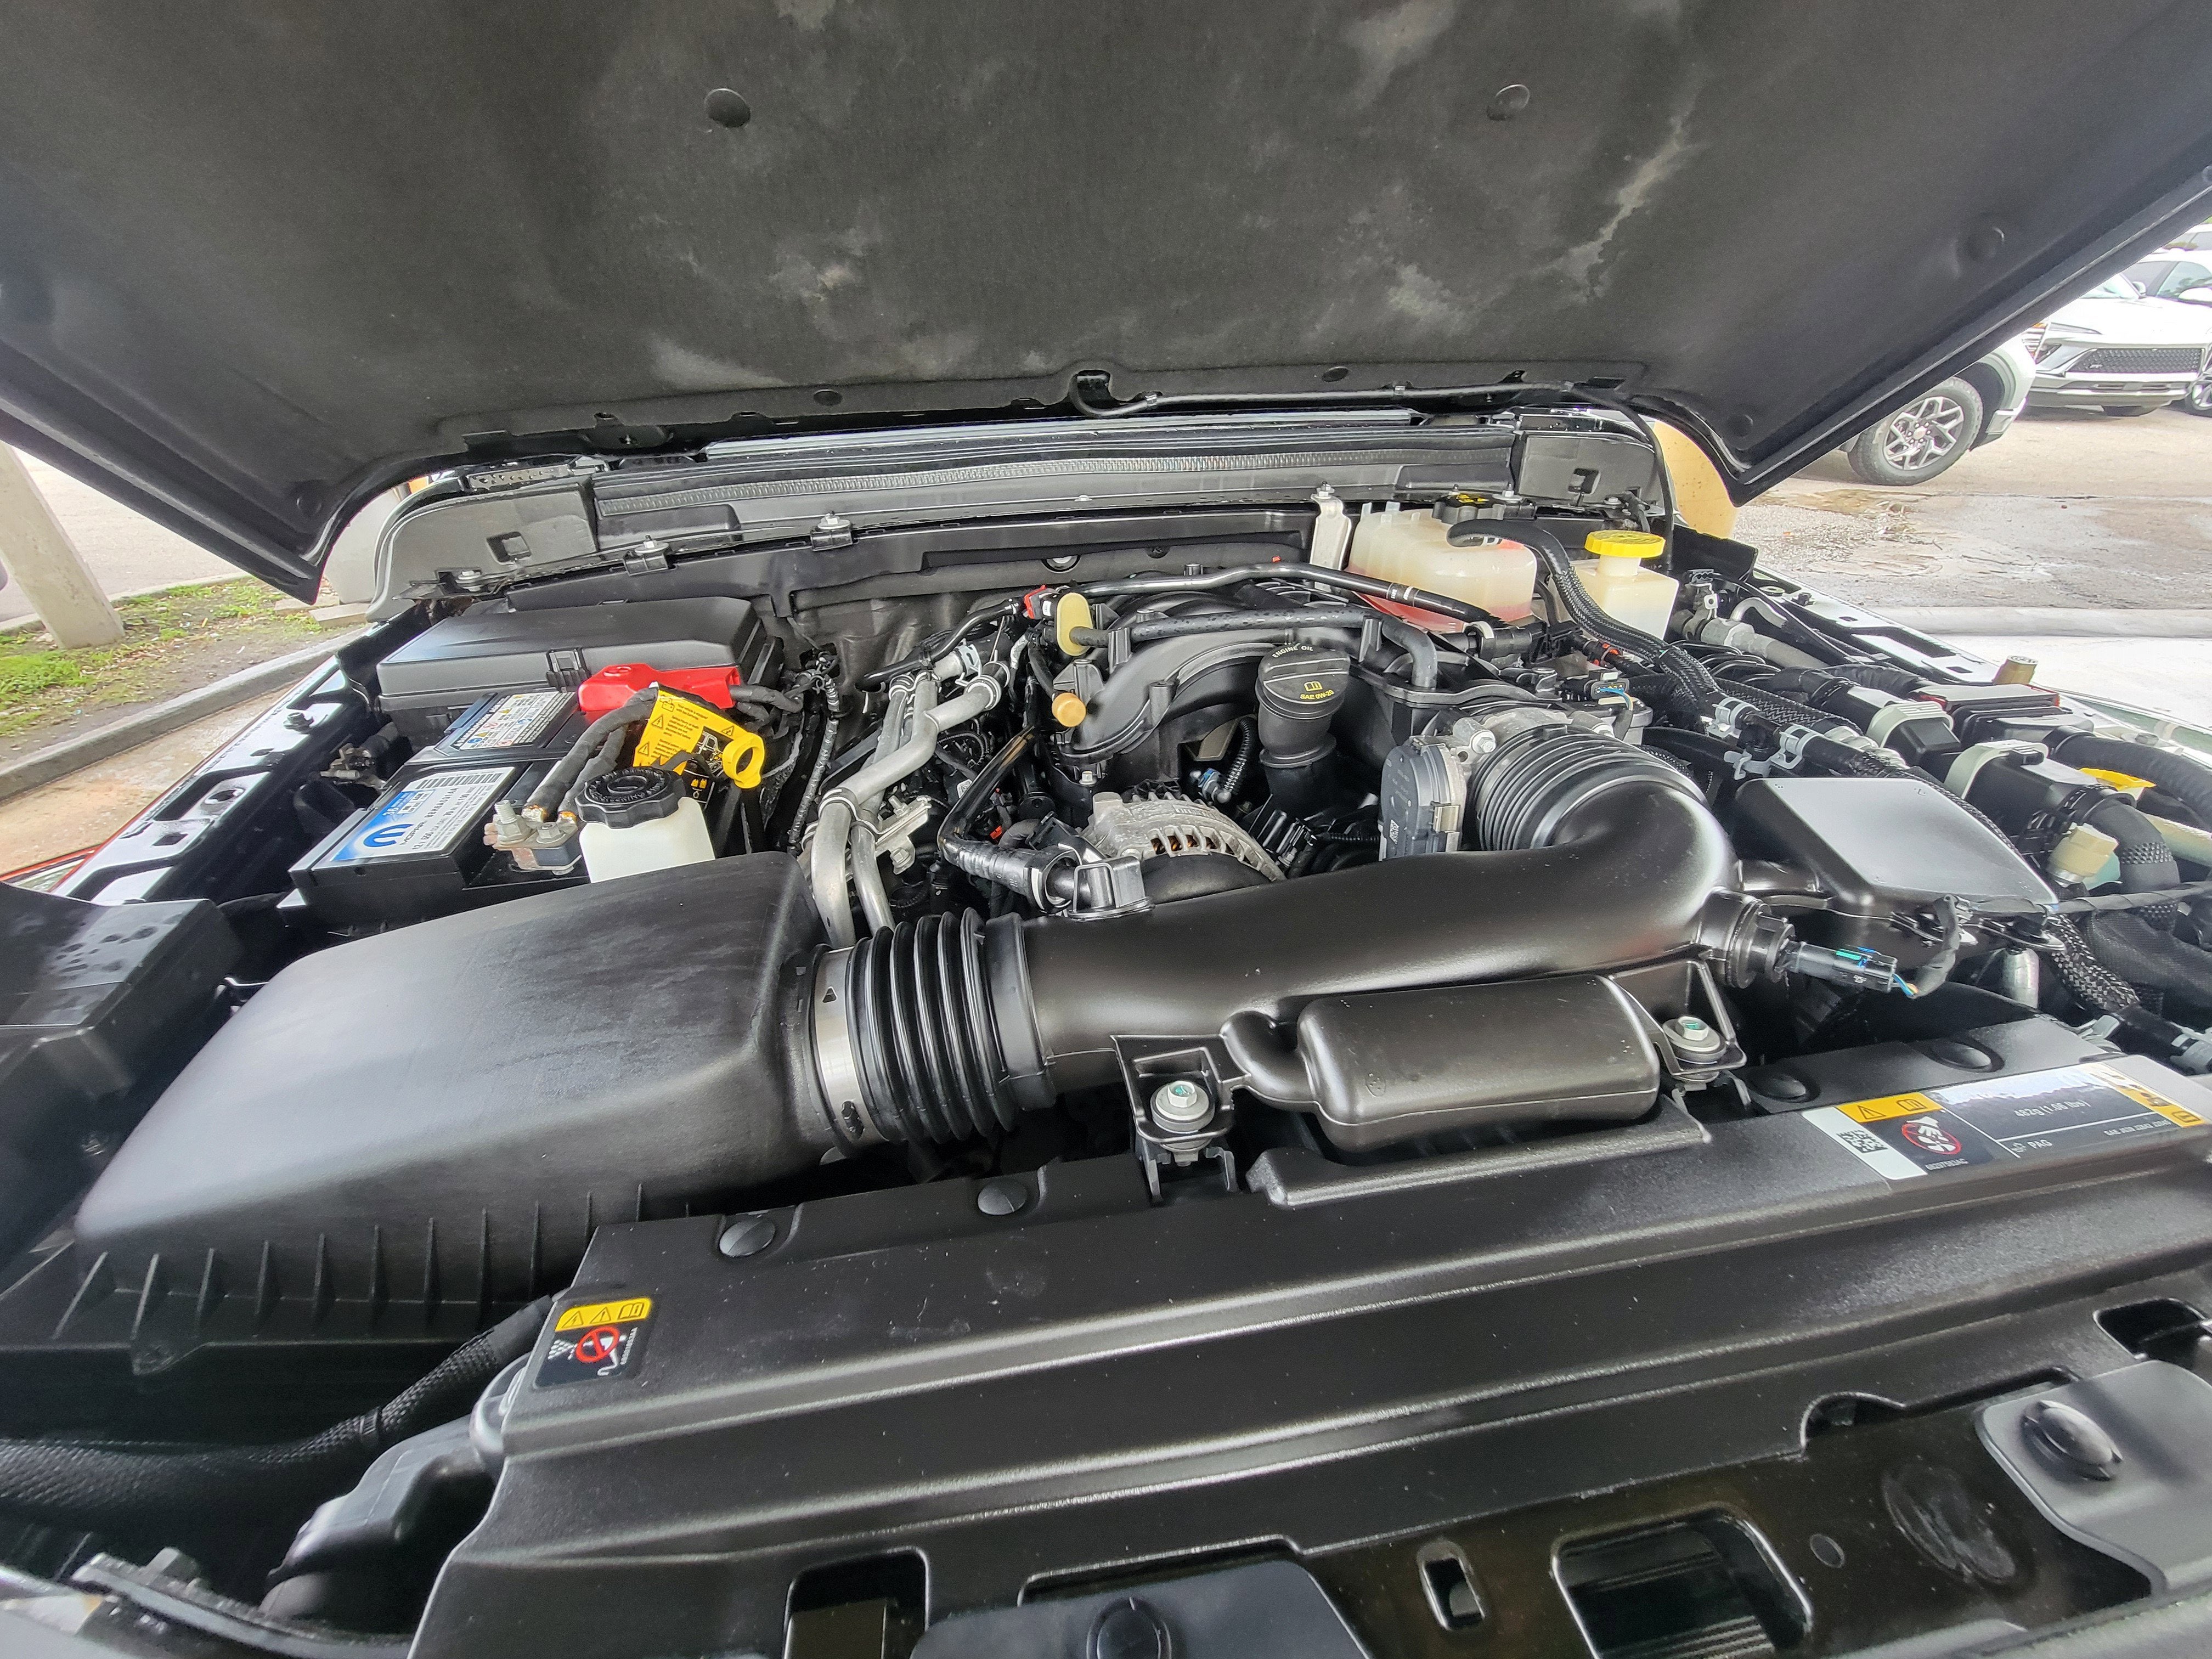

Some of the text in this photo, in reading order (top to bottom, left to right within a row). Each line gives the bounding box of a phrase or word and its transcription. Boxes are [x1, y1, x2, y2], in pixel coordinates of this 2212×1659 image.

[1272, 646, 1298, 658] ENGINE
[1315, 690, 1334, 699] 0W-20
[382, 807, 399, 816] 36
[399, 821, 425, 845] MOPAR
[2014, 1099, 2091, 1118] 482g (1.06 lbs)
[2027, 1139, 2053, 1150] PAG
